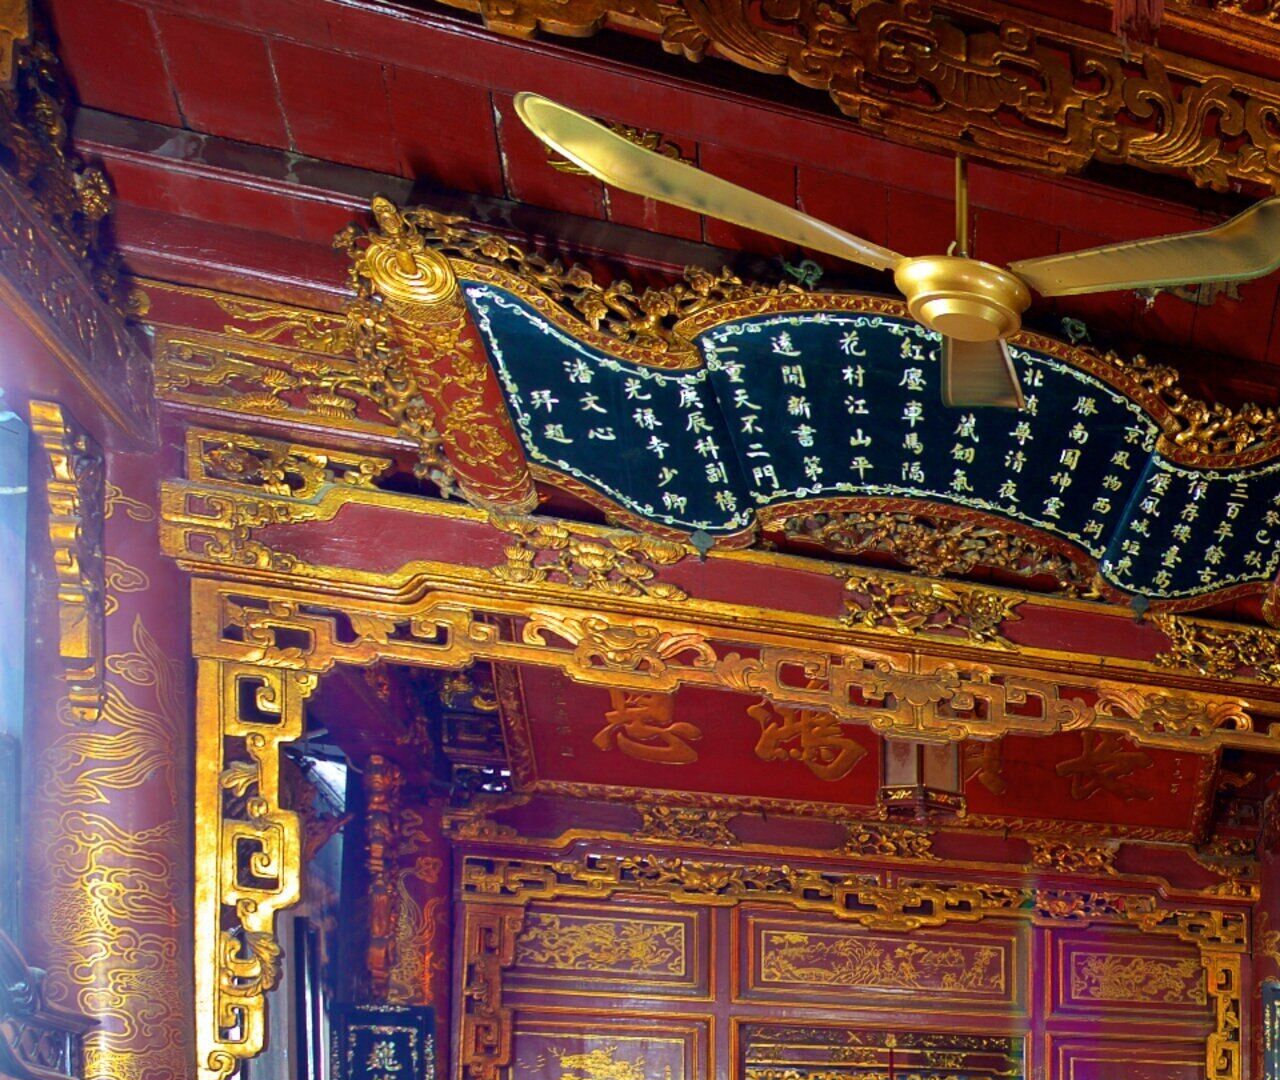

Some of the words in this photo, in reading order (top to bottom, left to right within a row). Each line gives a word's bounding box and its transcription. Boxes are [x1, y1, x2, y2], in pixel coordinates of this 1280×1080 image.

[563, 358, 617, 442] 潘文心
[840, 330, 874, 479] 花村江山平
